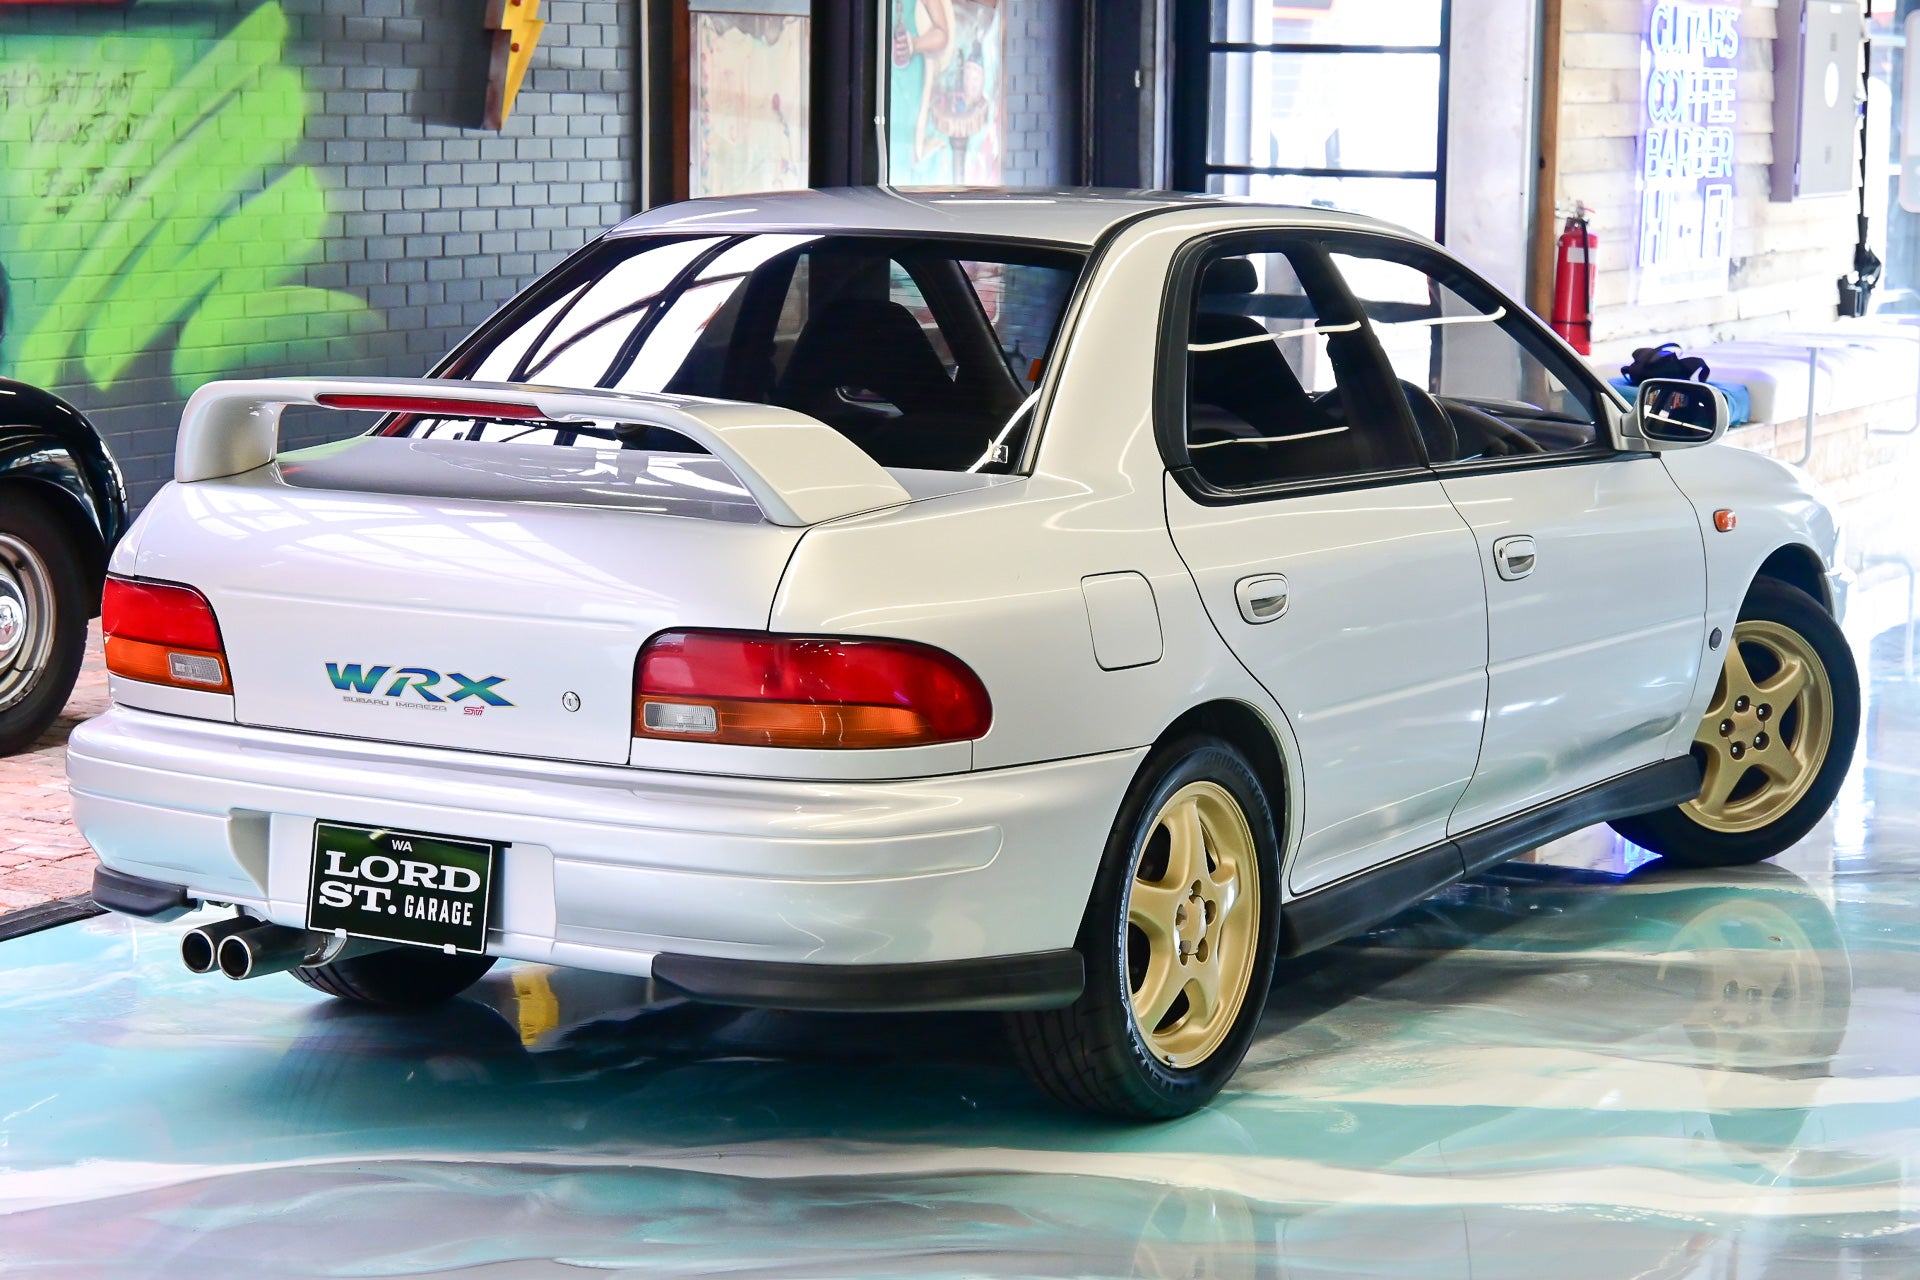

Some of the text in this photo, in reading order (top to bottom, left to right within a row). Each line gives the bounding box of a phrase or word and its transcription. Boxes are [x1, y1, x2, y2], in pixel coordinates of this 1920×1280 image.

[1650, 4, 1741, 59] GUITARS
[1647, 67, 1737, 123] COFFEE
[1644, 127, 1733, 178] BARBER
[325, 662, 517, 707] WRX
[343, 696, 447, 712] SUBARU IMPREZA
[391, 839, 413, 852] WA
[324, 850, 481, 893] LORD
[318, 880, 473, 926] ST. GARAGE
